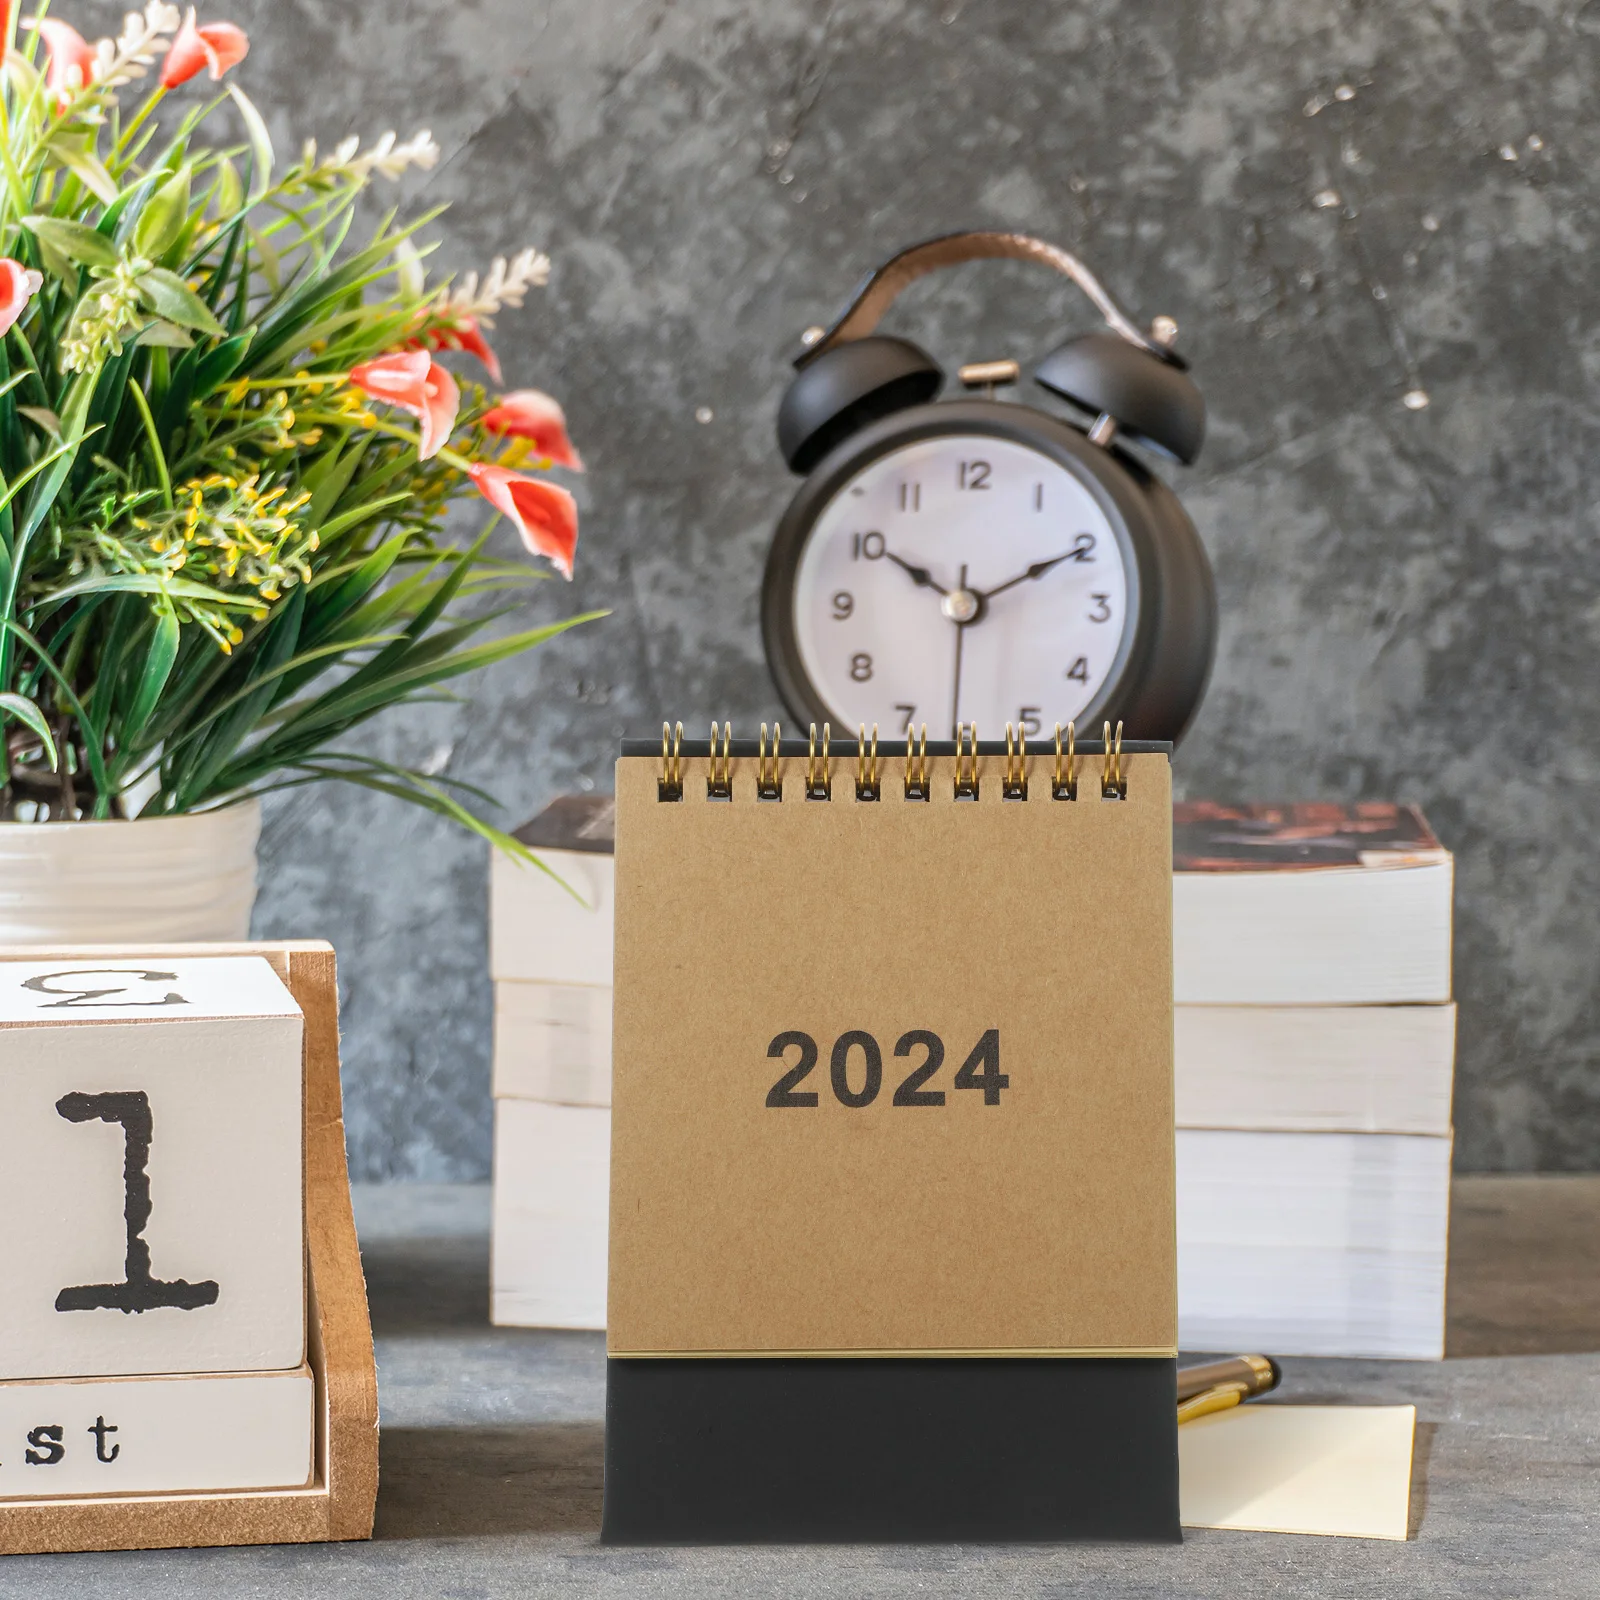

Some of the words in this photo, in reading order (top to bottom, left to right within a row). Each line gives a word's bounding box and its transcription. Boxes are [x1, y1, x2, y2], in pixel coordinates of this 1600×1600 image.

[959, 461, 991, 490] 12
[900, 482, 921, 512] 11
[1035, 482, 1044, 512] 1
[853, 531, 886, 560] 10
[1074, 533, 1097, 562] 2
[832, 592, 854, 620] 9
[1088, 594, 1111, 624] 3
[850, 653, 874, 682] 8
[1066, 657, 1089, 685] 4
[895, 704, 917, 735] 7
[1018, 706, 1042, 737] 5
[765, 1029, 1010, 1108] 2024
[55, 1090, 220, 1314] 1
[0, 1415, 120, 1466] st
